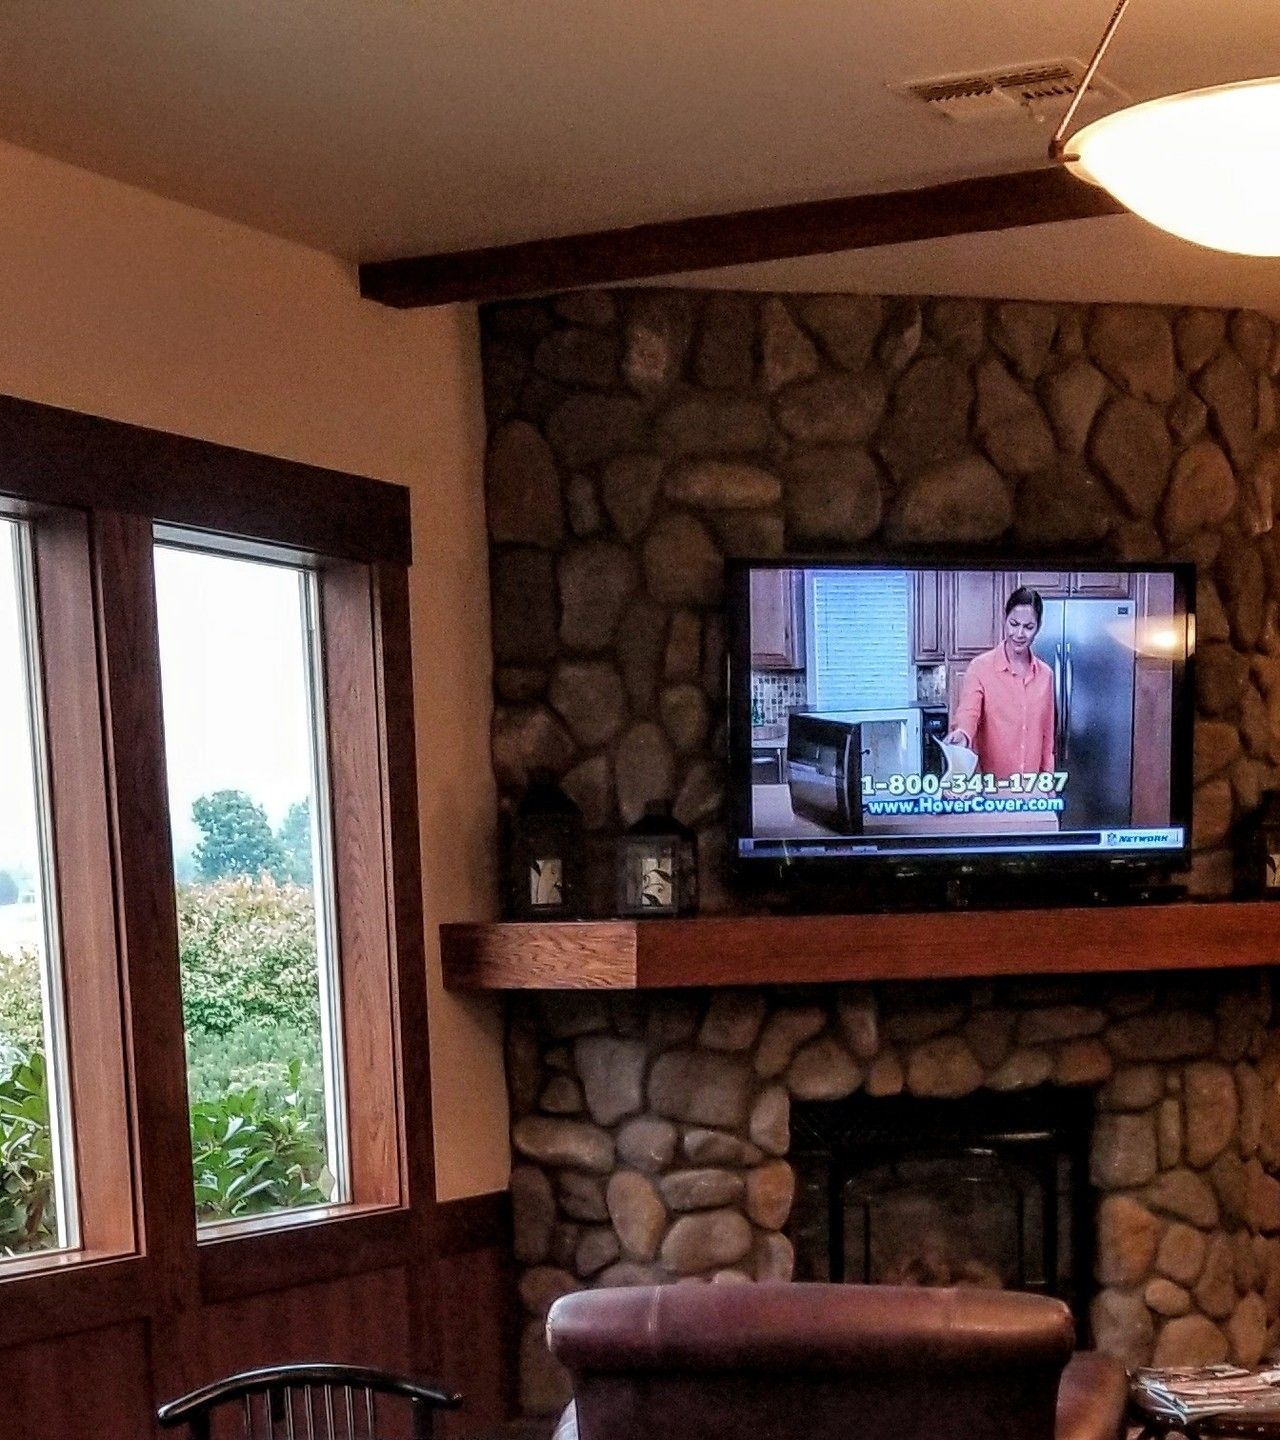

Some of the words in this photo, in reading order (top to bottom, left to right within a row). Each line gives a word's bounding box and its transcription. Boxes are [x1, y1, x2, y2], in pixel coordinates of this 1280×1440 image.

[861, 771, 1068, 796] 1-800-341-1787
[868, 797, 1065, 815] www.HoverCover.com
[1119, 834, 1170, 843] NETWORK
